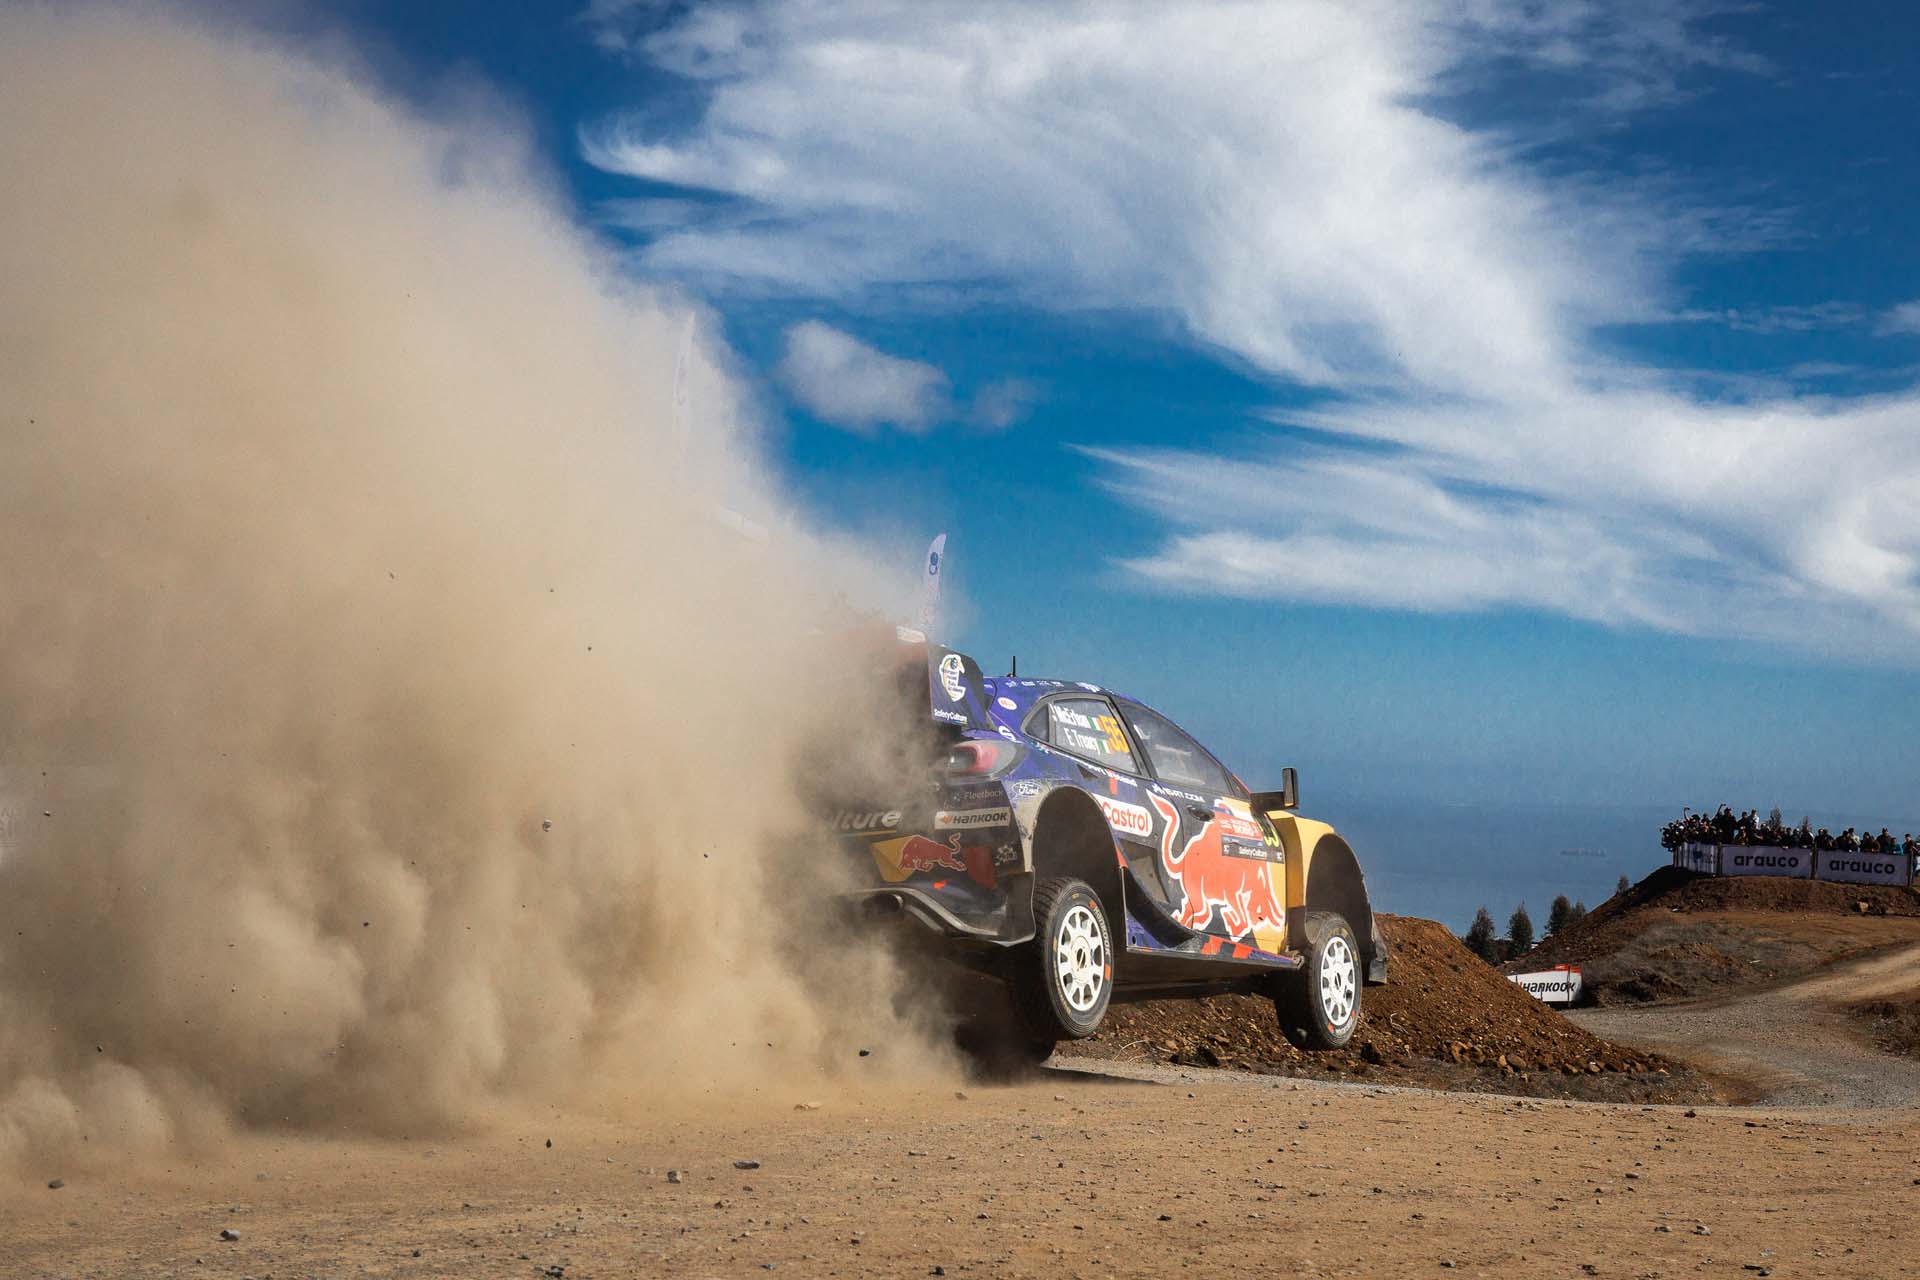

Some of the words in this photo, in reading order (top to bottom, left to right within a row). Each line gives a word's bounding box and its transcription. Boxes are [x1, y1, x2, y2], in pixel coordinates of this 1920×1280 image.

[1064, 727, 1075, 746] E
[1099, 714, 1130, 753] 55
[1102, 801, 1149, 832] Castrol
[1734, 854, 1799, 869] arauco
[1829, 859, 1895, 875] arauco
